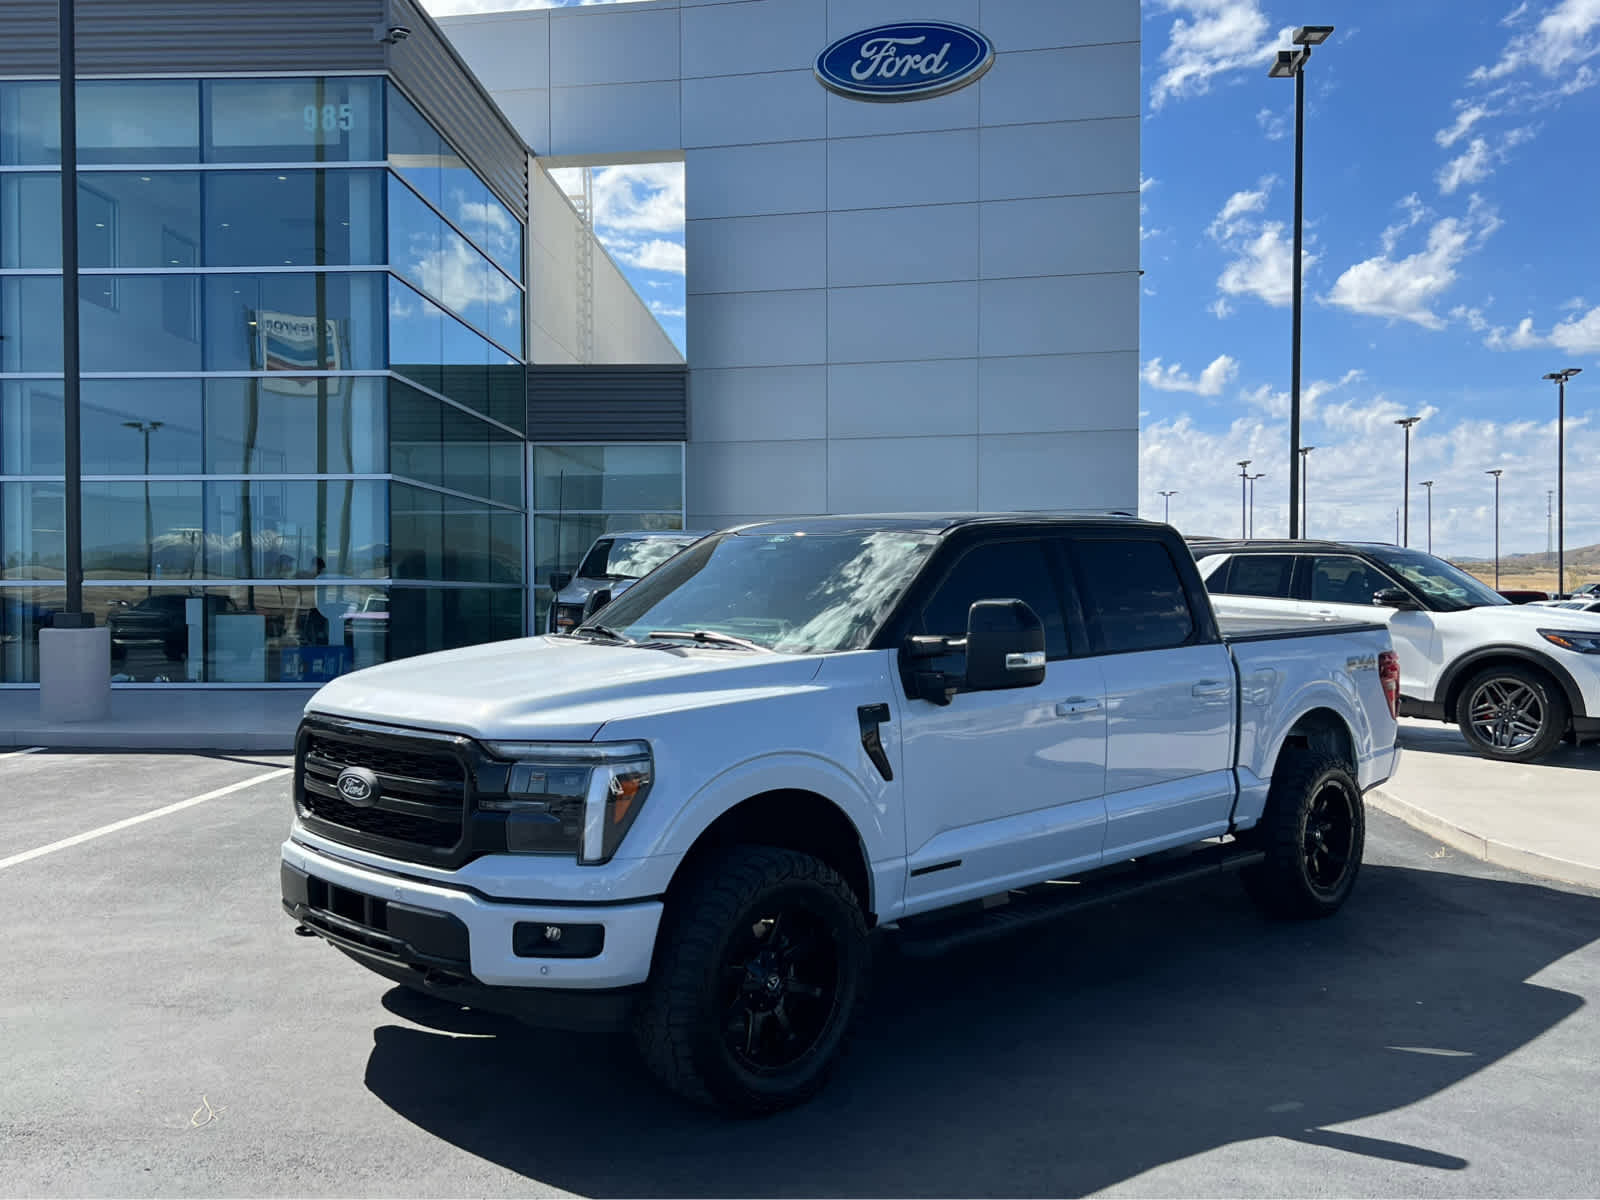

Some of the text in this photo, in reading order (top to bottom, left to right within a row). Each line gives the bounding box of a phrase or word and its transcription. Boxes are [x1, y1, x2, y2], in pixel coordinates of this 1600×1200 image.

[850, 36, 951, 80] Ford
[303, 105, 353, 131] 985
[343, 777, 365, 796] Ford
